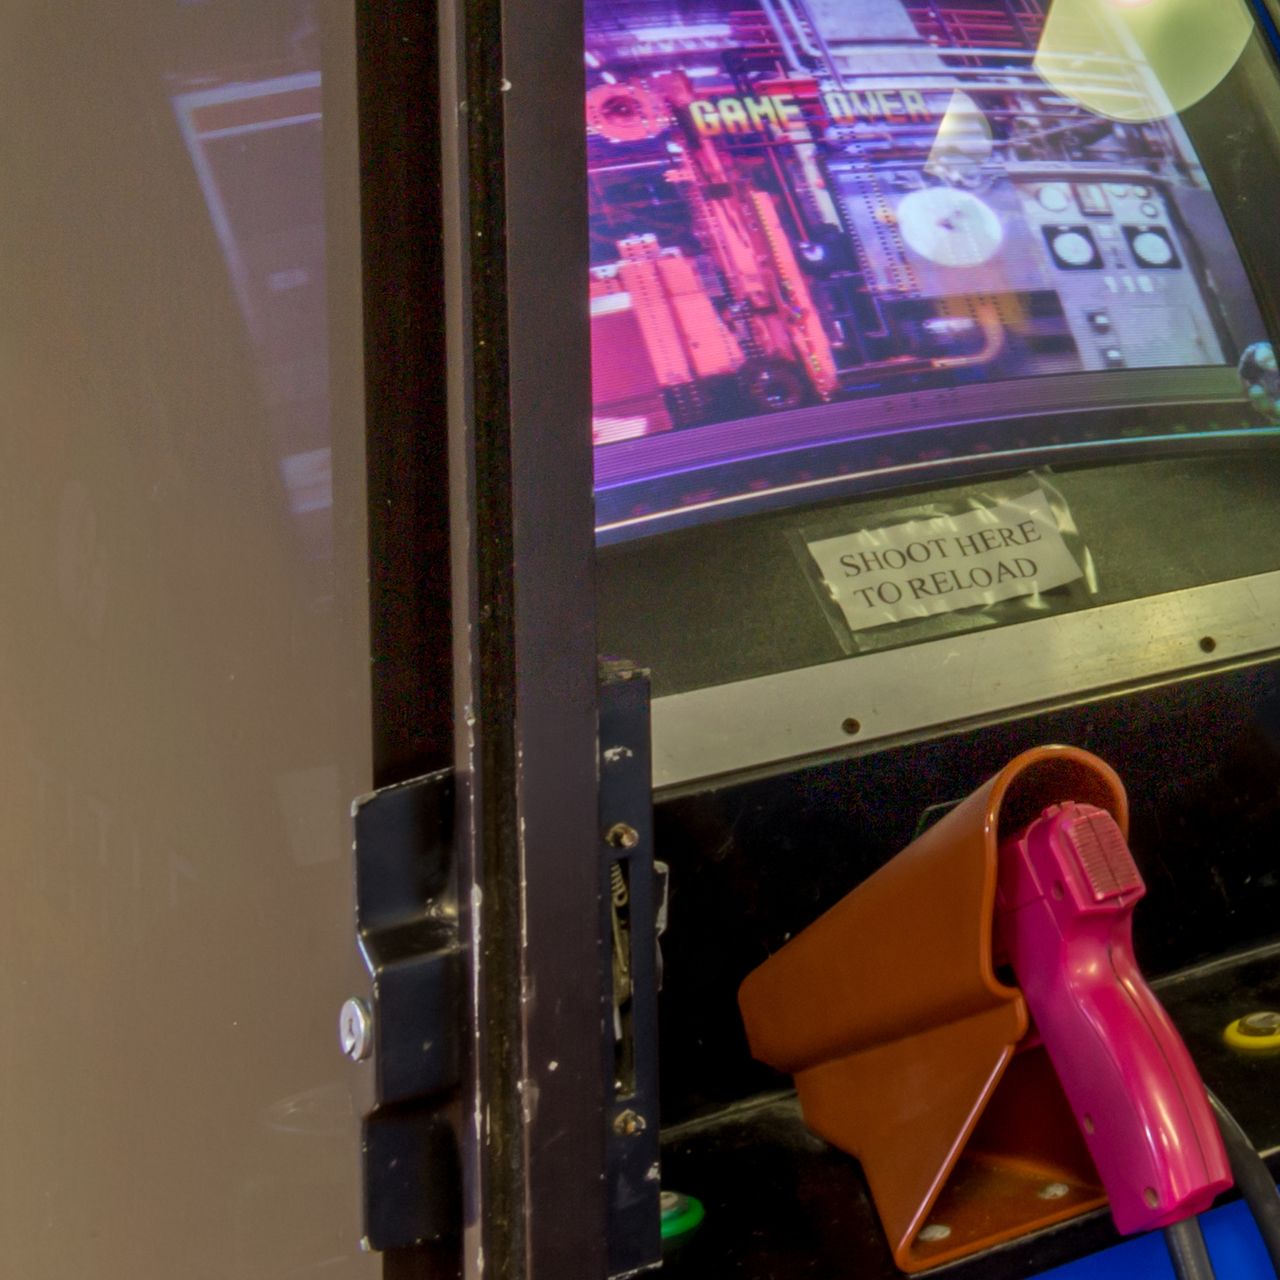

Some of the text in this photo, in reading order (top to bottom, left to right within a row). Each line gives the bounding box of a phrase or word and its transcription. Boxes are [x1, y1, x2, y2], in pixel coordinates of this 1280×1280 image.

[690, 88, 936, 137] GAME OVER
[838, 519, 1043, 579] SHOOT HERE
[852, 557, 1039, 610] TO RELOAD
